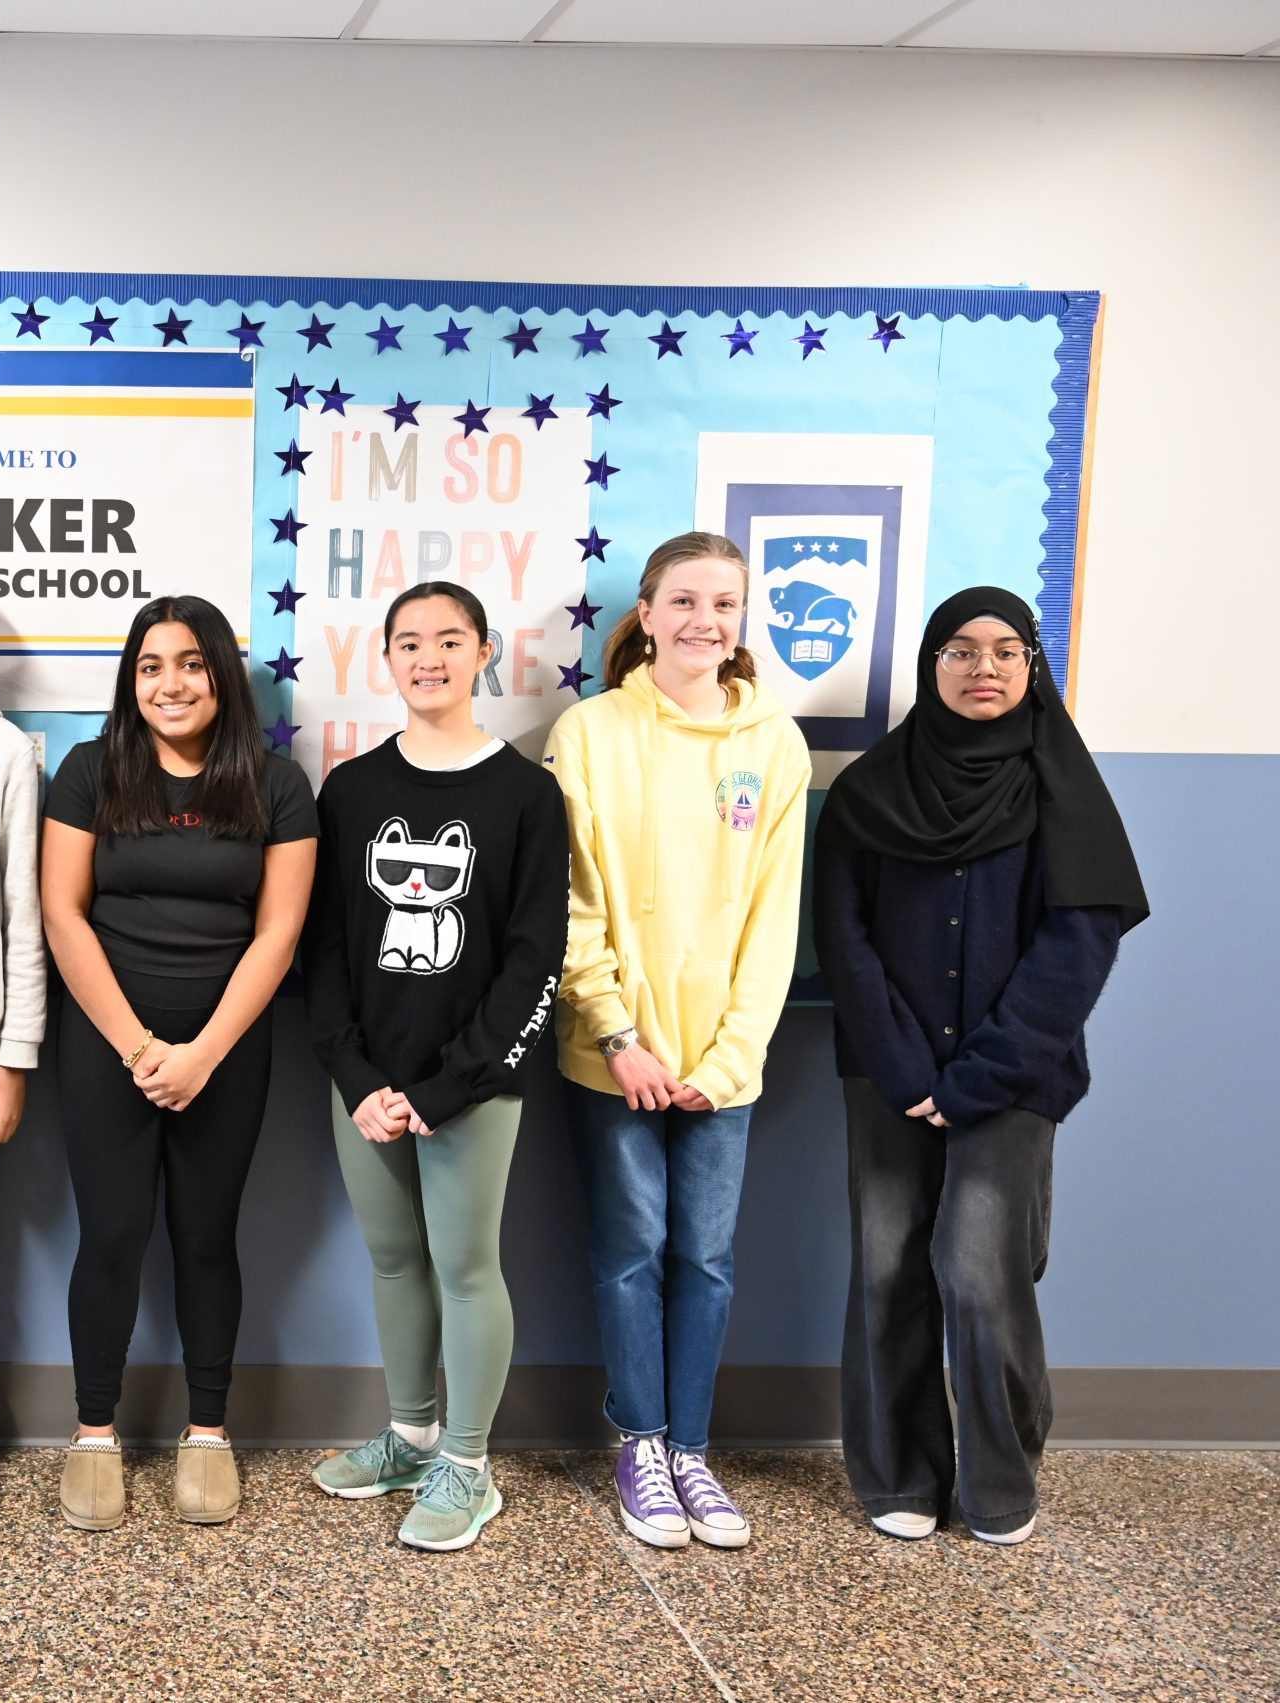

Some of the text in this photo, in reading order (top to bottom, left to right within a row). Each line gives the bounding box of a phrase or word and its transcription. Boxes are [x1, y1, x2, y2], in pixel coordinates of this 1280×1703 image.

[40, 449, 77, 469] TO
[330, 430, 523, 504] I'M SO
[327, 528, 538, 601] HAPPY
[503, 1042, 527, 1069] XX
